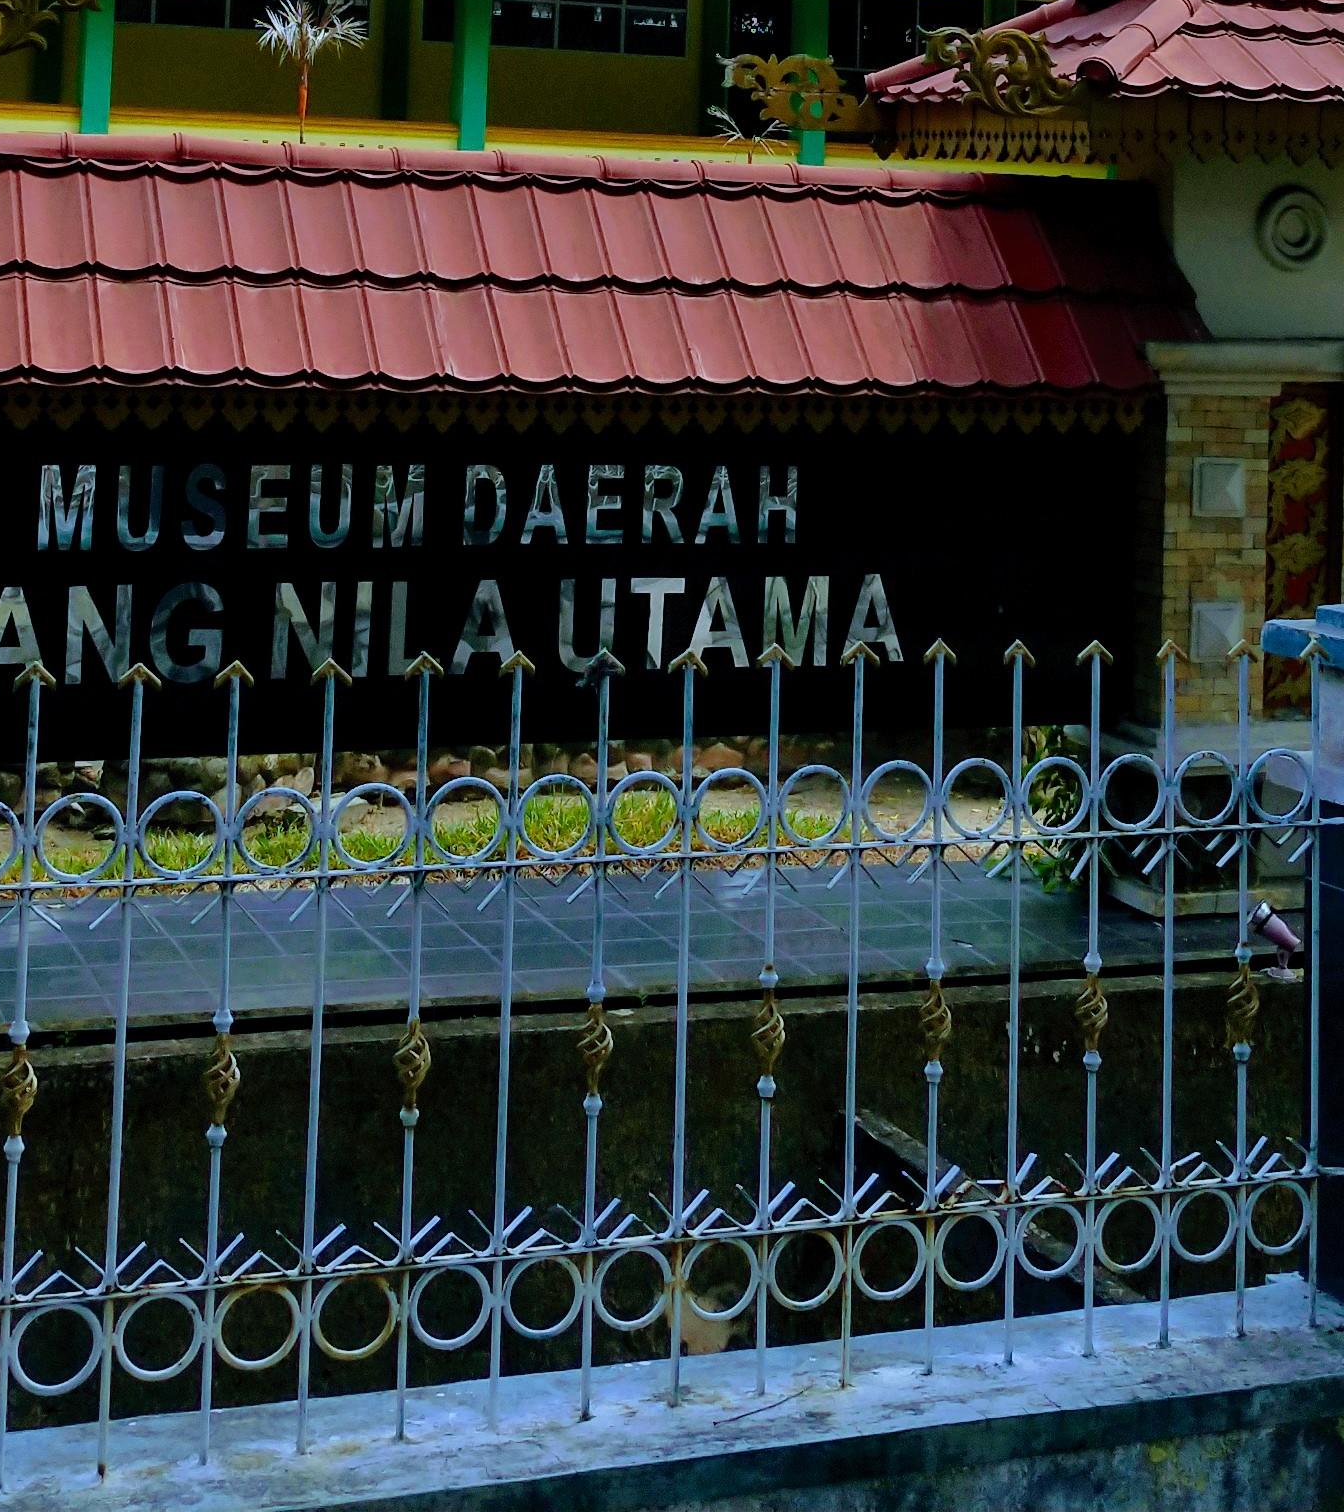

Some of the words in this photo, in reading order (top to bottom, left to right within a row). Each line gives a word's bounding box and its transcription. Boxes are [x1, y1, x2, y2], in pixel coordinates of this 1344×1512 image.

[36, 464, 427, 552] MUSEUM
[462, 464, 799, 546] DAERAH
[270, 578, 521, 681] NILA
[557, 573, 904, 674] UTAMA
